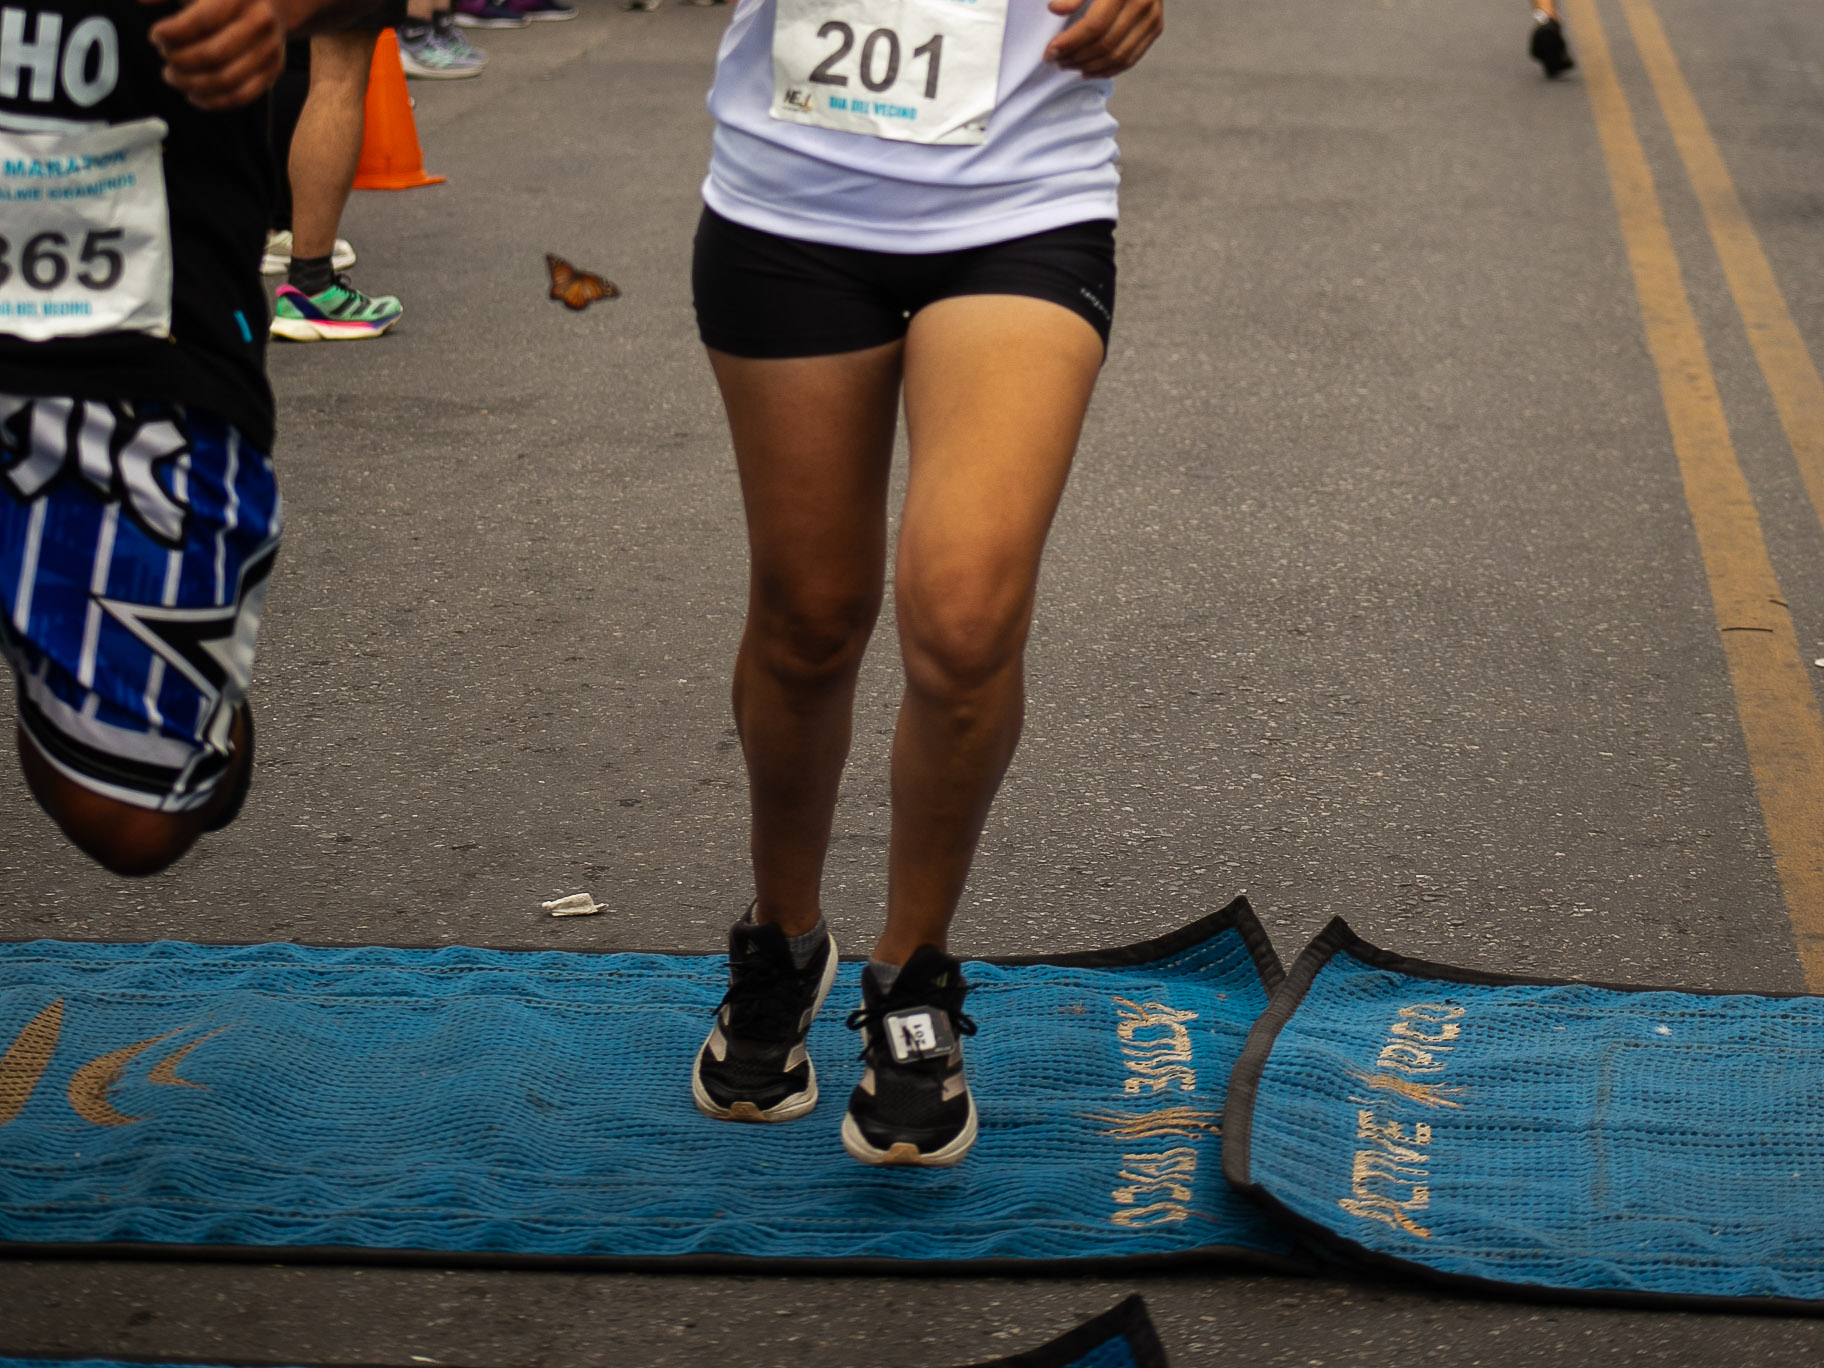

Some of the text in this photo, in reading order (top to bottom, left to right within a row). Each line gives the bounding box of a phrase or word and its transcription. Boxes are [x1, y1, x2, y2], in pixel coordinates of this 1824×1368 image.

[808, 20, 944, 100] 201
[873, 102, 918, 120] VECINO
[0, 227, 126, 293] 65
